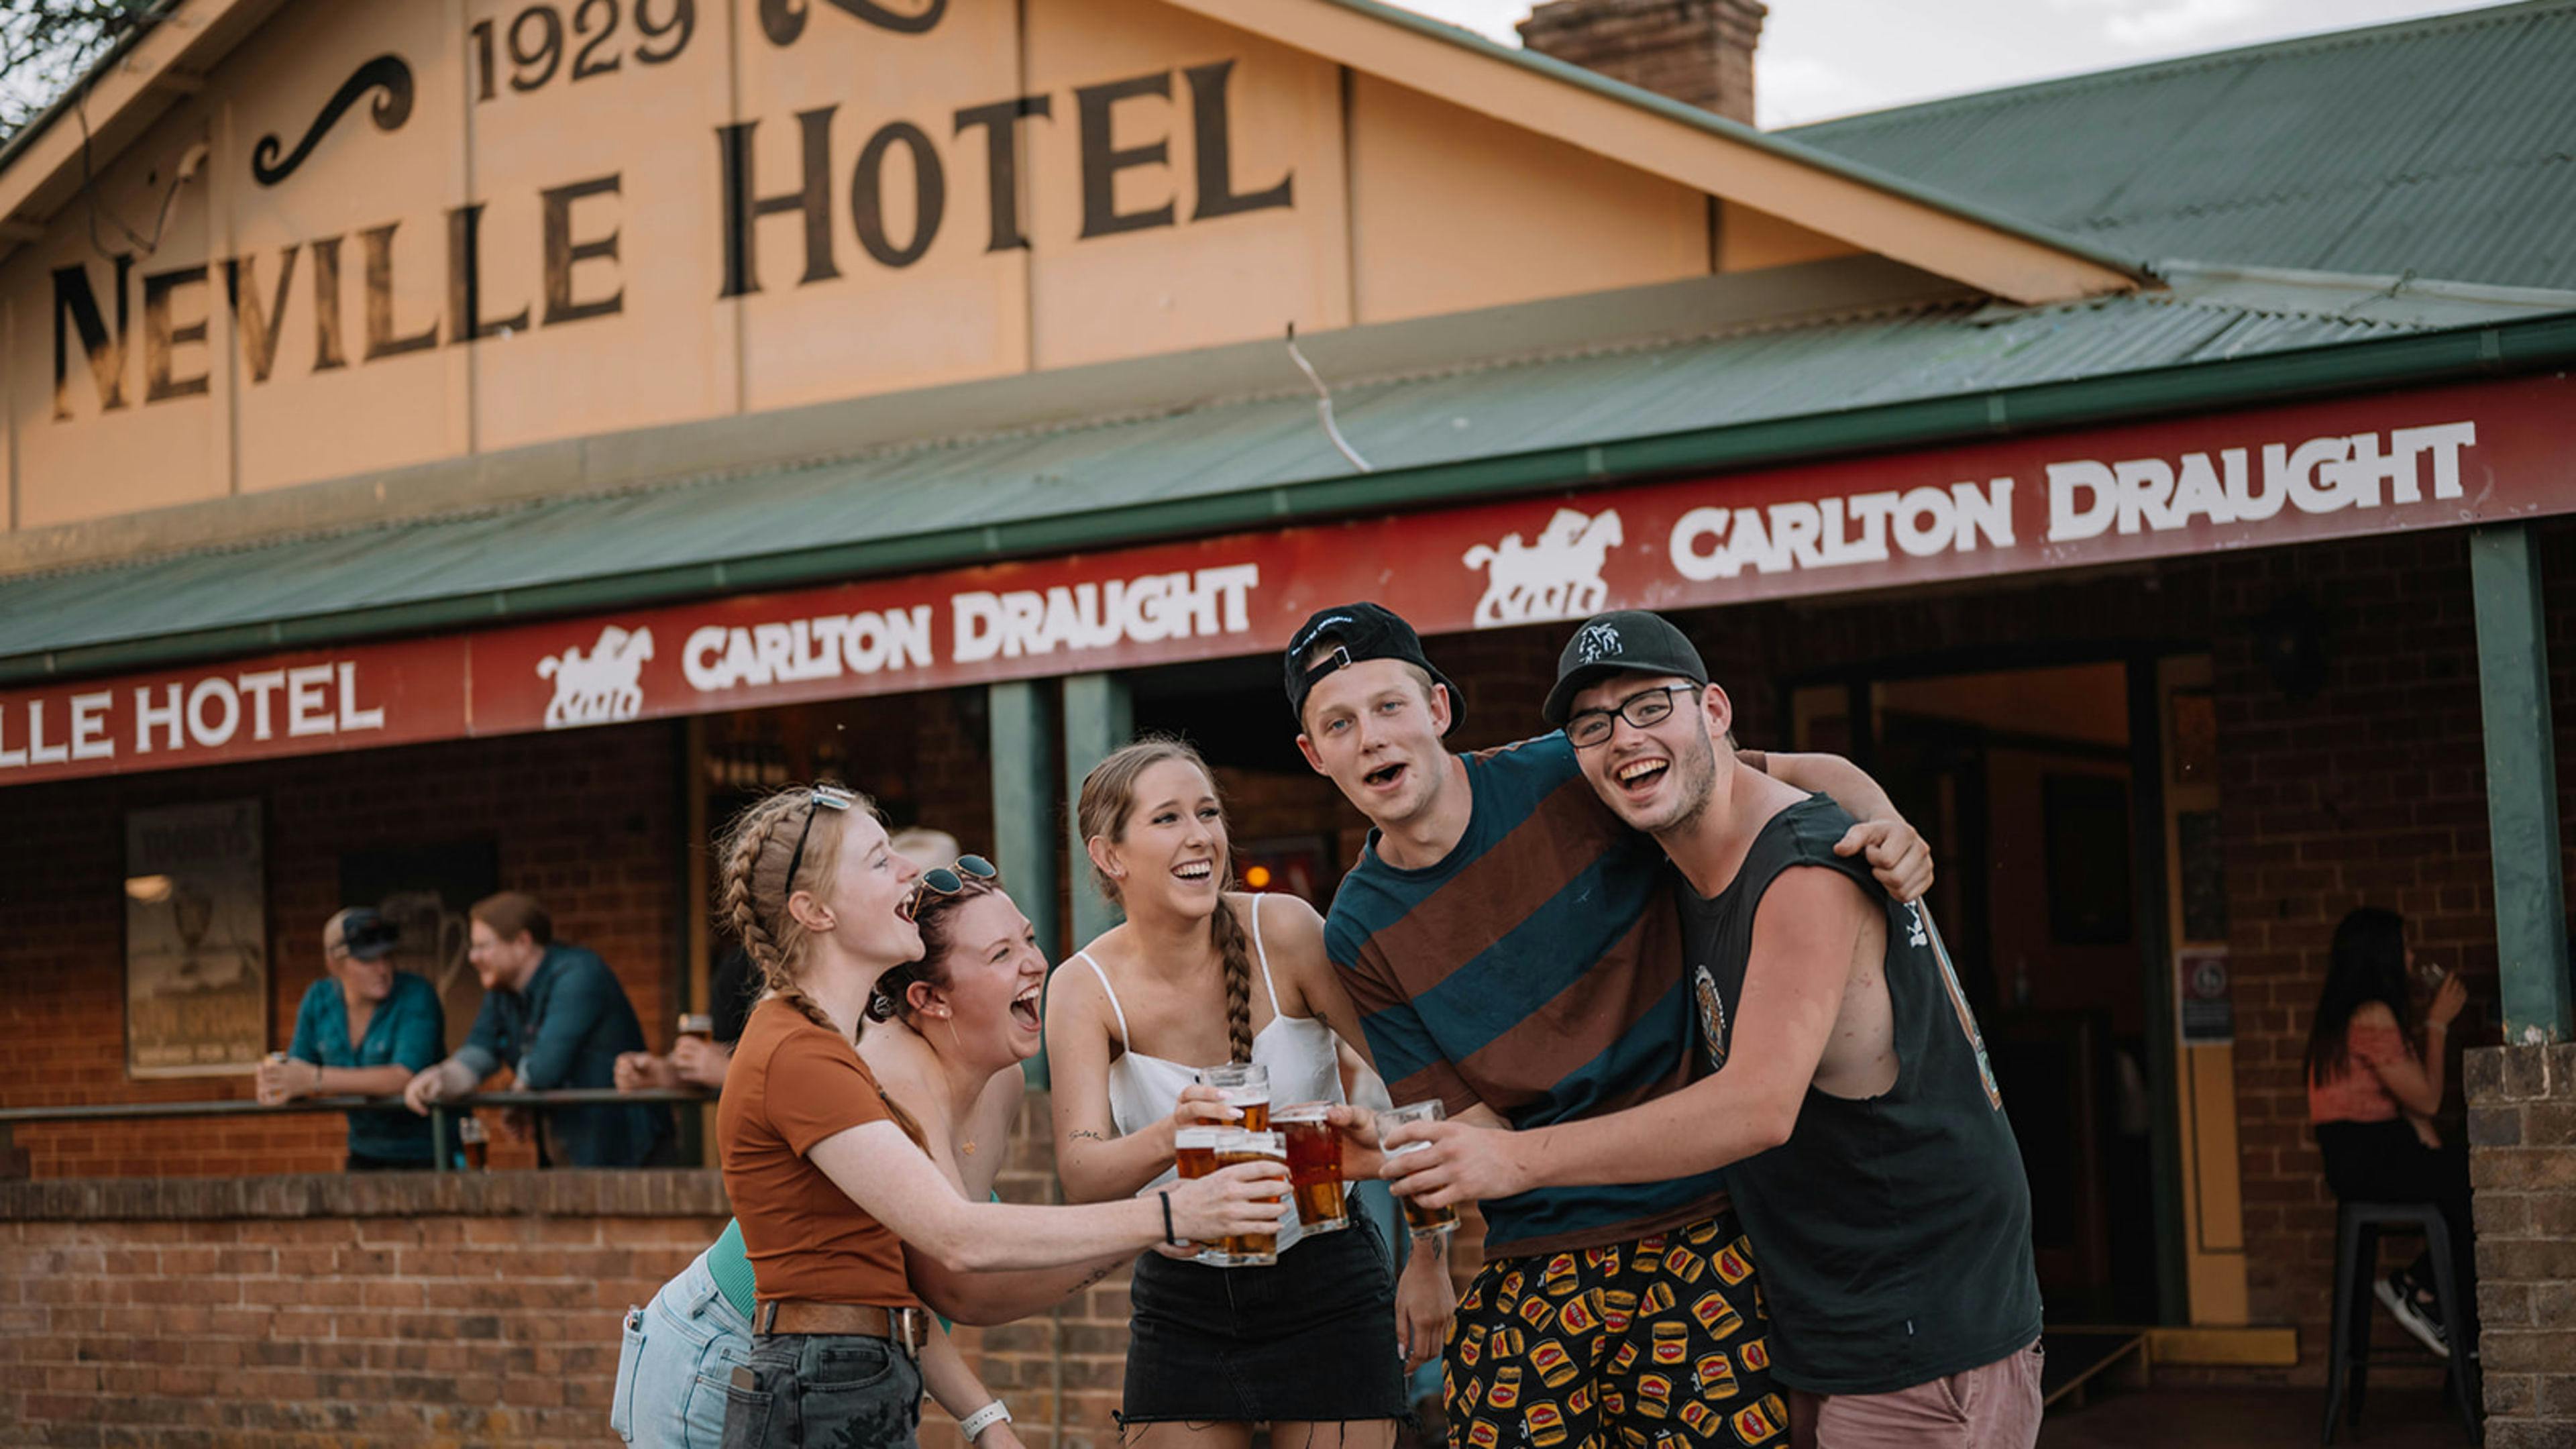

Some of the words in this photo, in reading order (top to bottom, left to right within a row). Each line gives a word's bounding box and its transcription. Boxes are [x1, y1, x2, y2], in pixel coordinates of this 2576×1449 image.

[470, 0, 696, 103] 1929
[52, 171, 625, 423] NEVILLE
[714, 58, 1295, 300] HOTEL
[1668, 477, 2016, 582] CARLTON
[2045, 421, 2476, 542] DRAUGHT
[682, 605, 932, 693] CARLTON
[952, 563, 1258, 663] DRAUGHT
[135, 661, 385, 754] HOTEL
